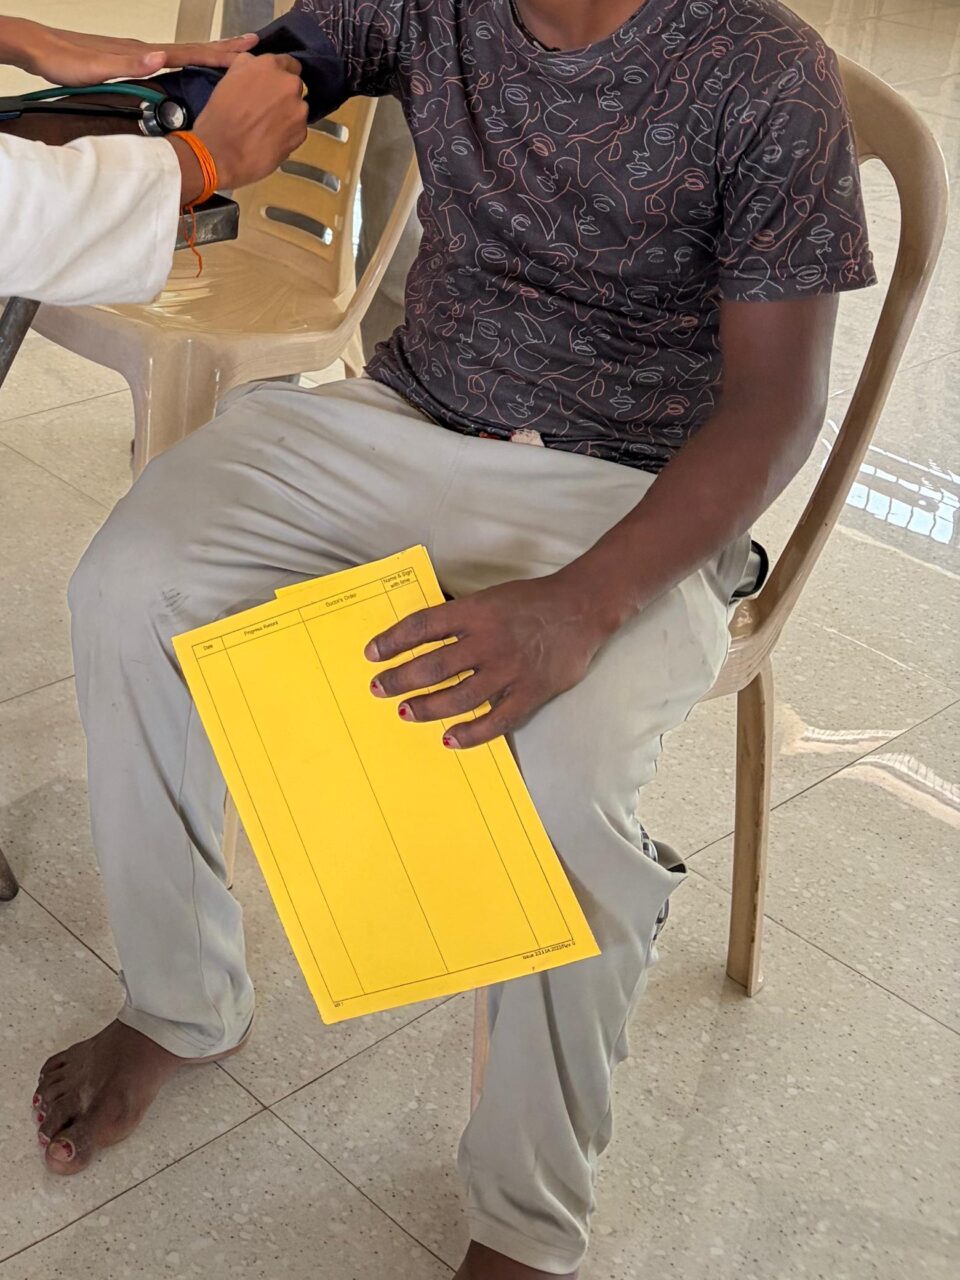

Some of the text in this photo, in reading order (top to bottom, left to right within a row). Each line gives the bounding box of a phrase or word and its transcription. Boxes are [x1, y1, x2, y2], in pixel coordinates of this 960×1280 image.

[383, 575, 397, 584] Name
[402, 569, 412, 578] Sign
[390, 577, 410, 589] with time
[344, 592, 357, 601] Order
[203, 643, 214, 651] Date
